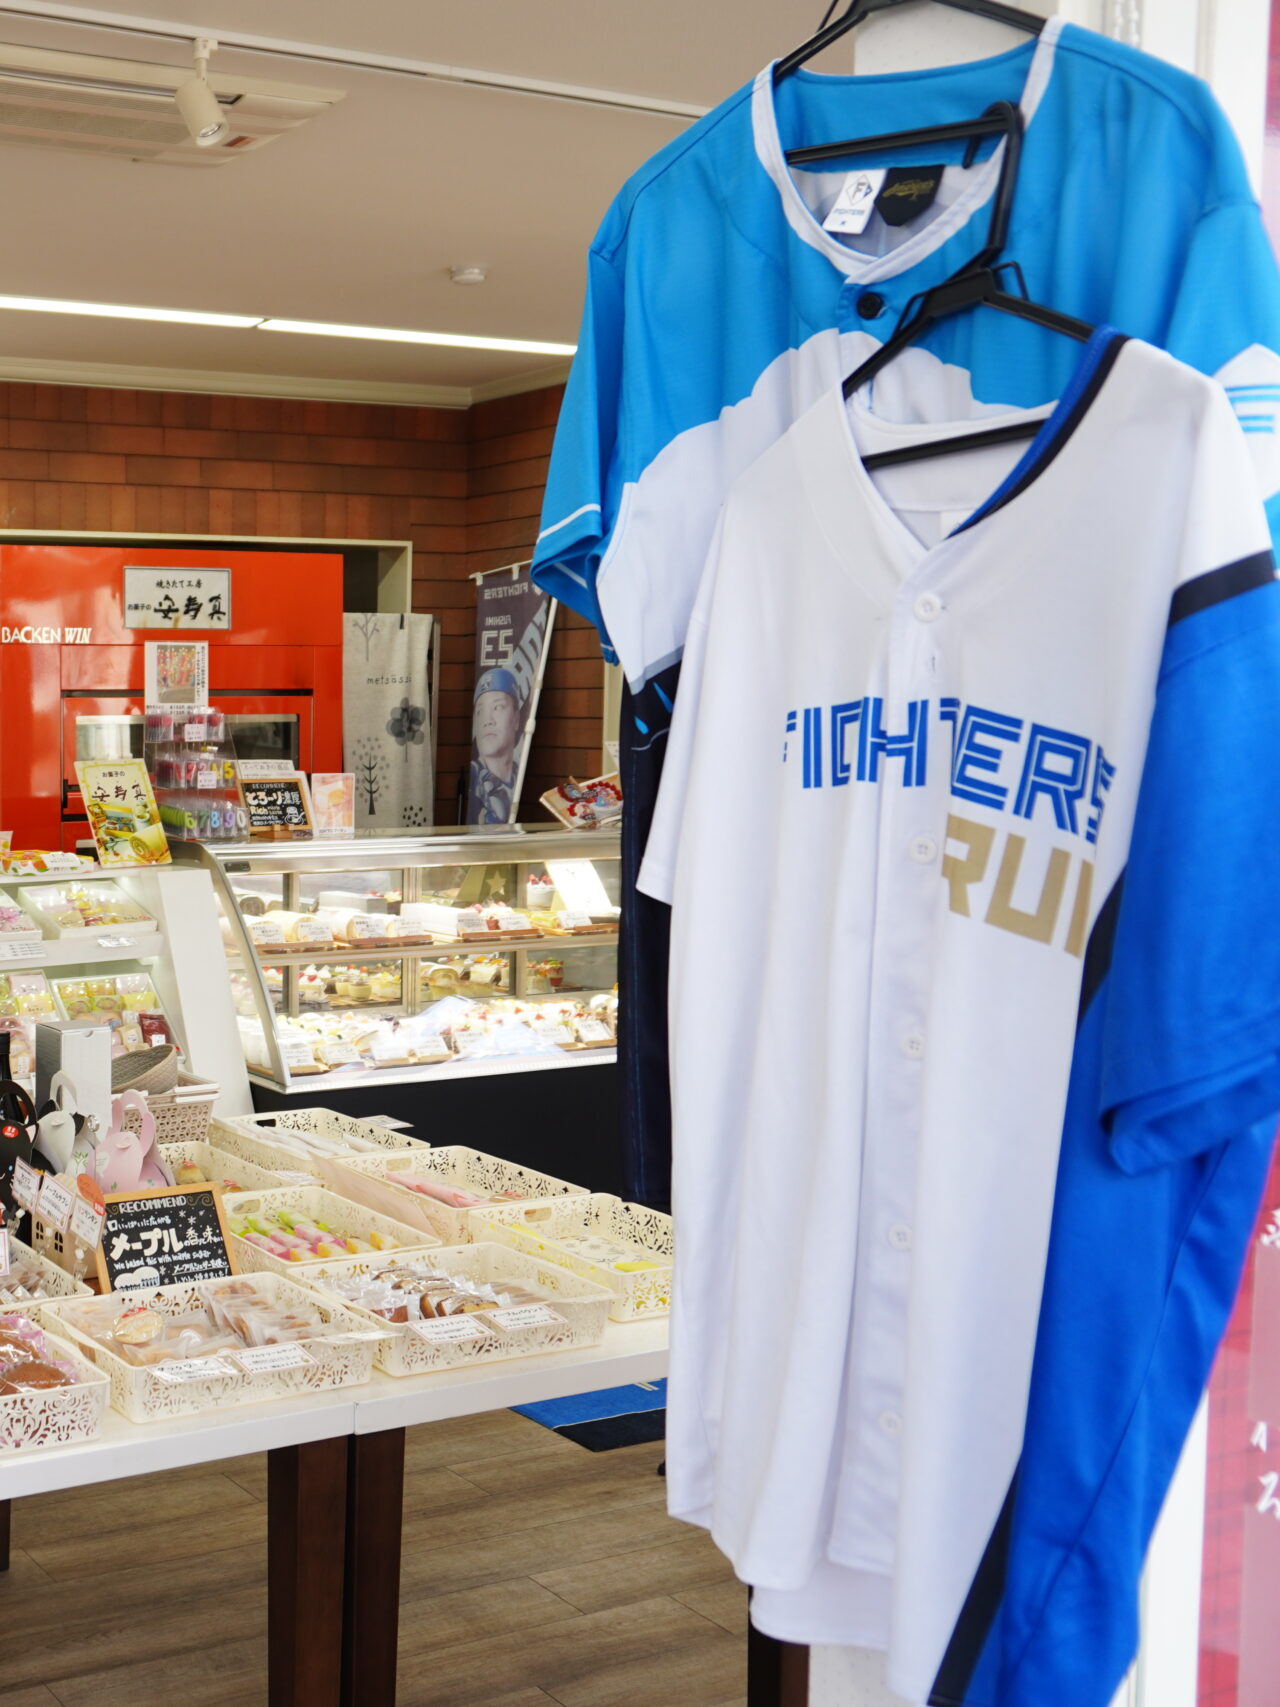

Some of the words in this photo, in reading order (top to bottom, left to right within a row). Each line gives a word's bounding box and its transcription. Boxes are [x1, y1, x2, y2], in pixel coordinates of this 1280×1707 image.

[155, 579, 203, 589] 焼きたて工房
[127, 603, 152, 611] お菓子の
[1, 627, 62, 644] BACKEN
[64, 627, 92, 644] WIN
[118, 1195, 187, 1214] RECOMMEND
